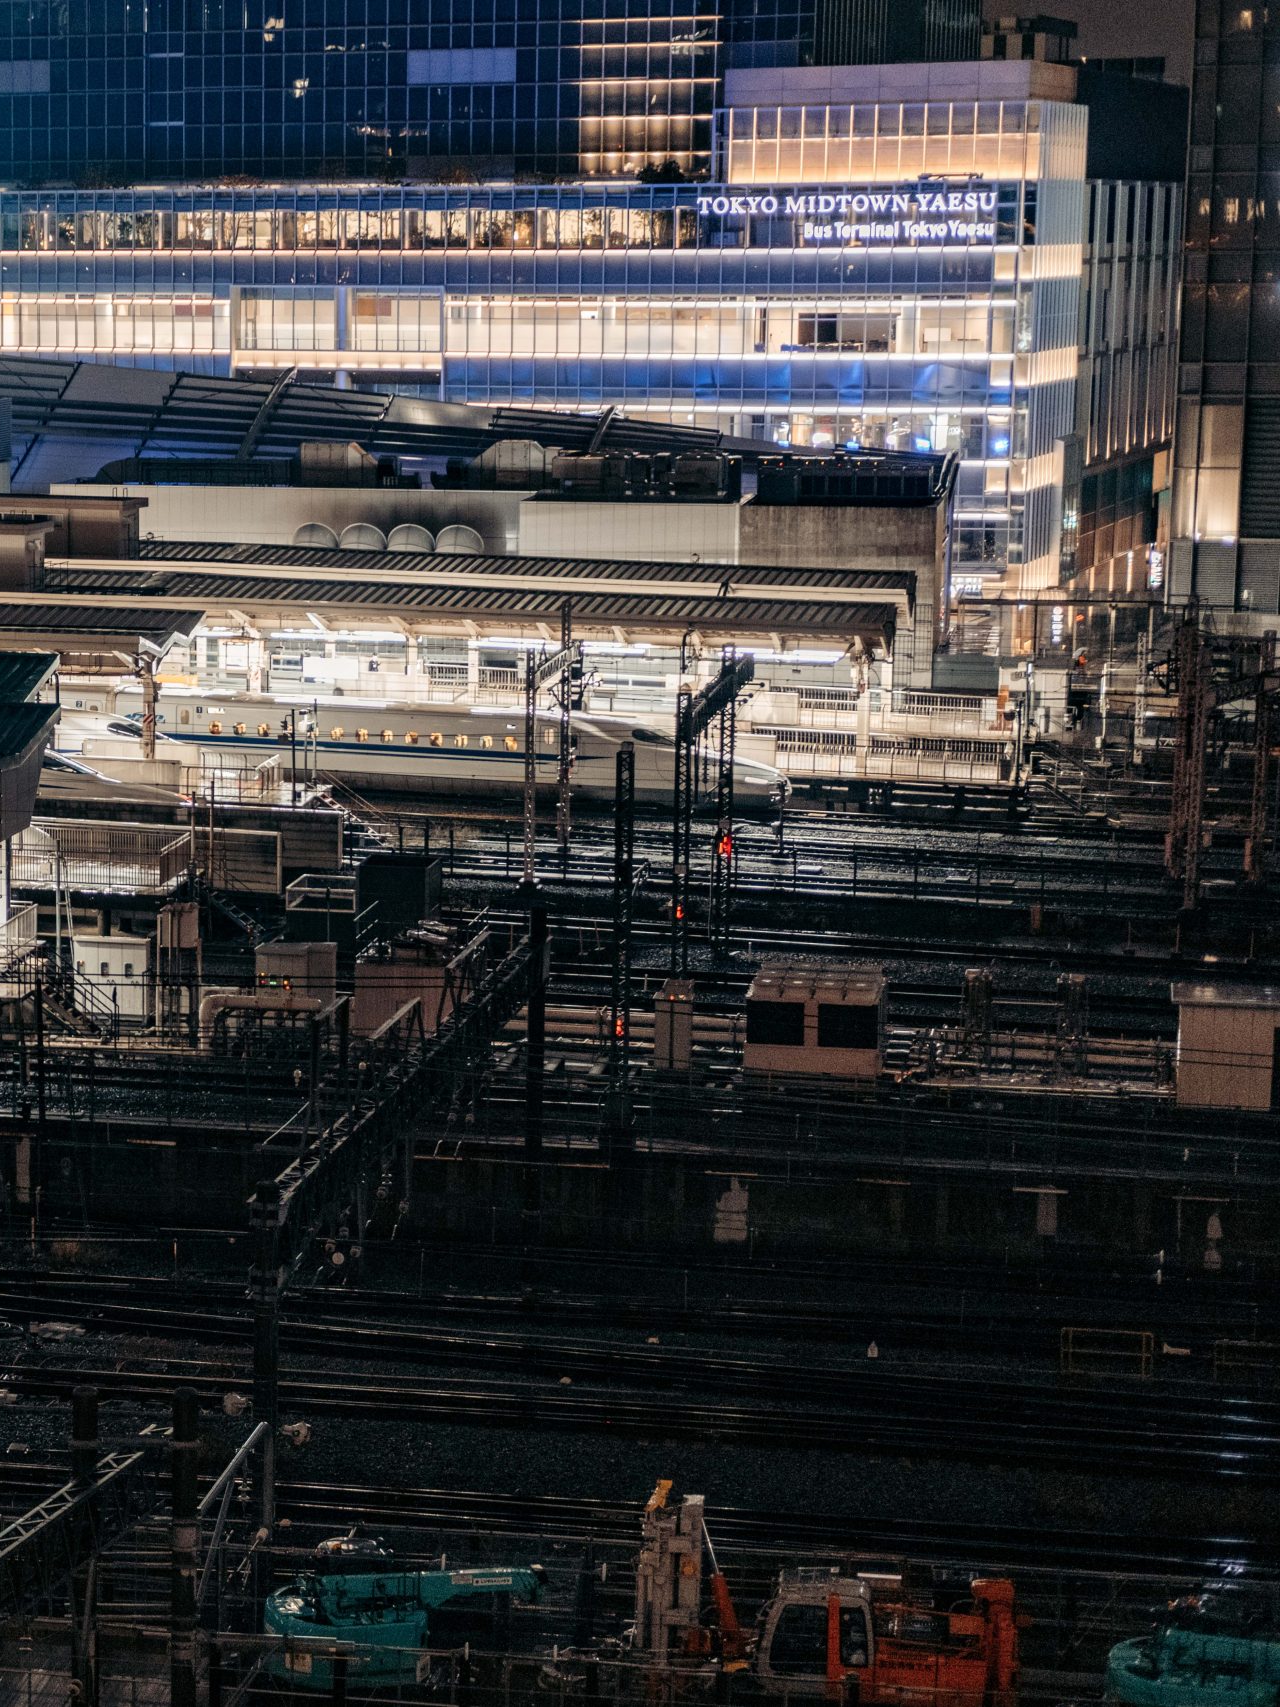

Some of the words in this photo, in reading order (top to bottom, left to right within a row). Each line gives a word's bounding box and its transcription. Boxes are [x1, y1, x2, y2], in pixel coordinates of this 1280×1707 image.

[697, 195, 778, 215] TOKYO
[785, 194, 909, 213] MIDTOWN
[915, 191, 998, 212] YAESU
[804, 222, 833, 239] Bus
[834, 221, 899, 239] Terminal
[902, 220, 948, 239] Tokyo
[948, 220, 995, 238] Yaesu
